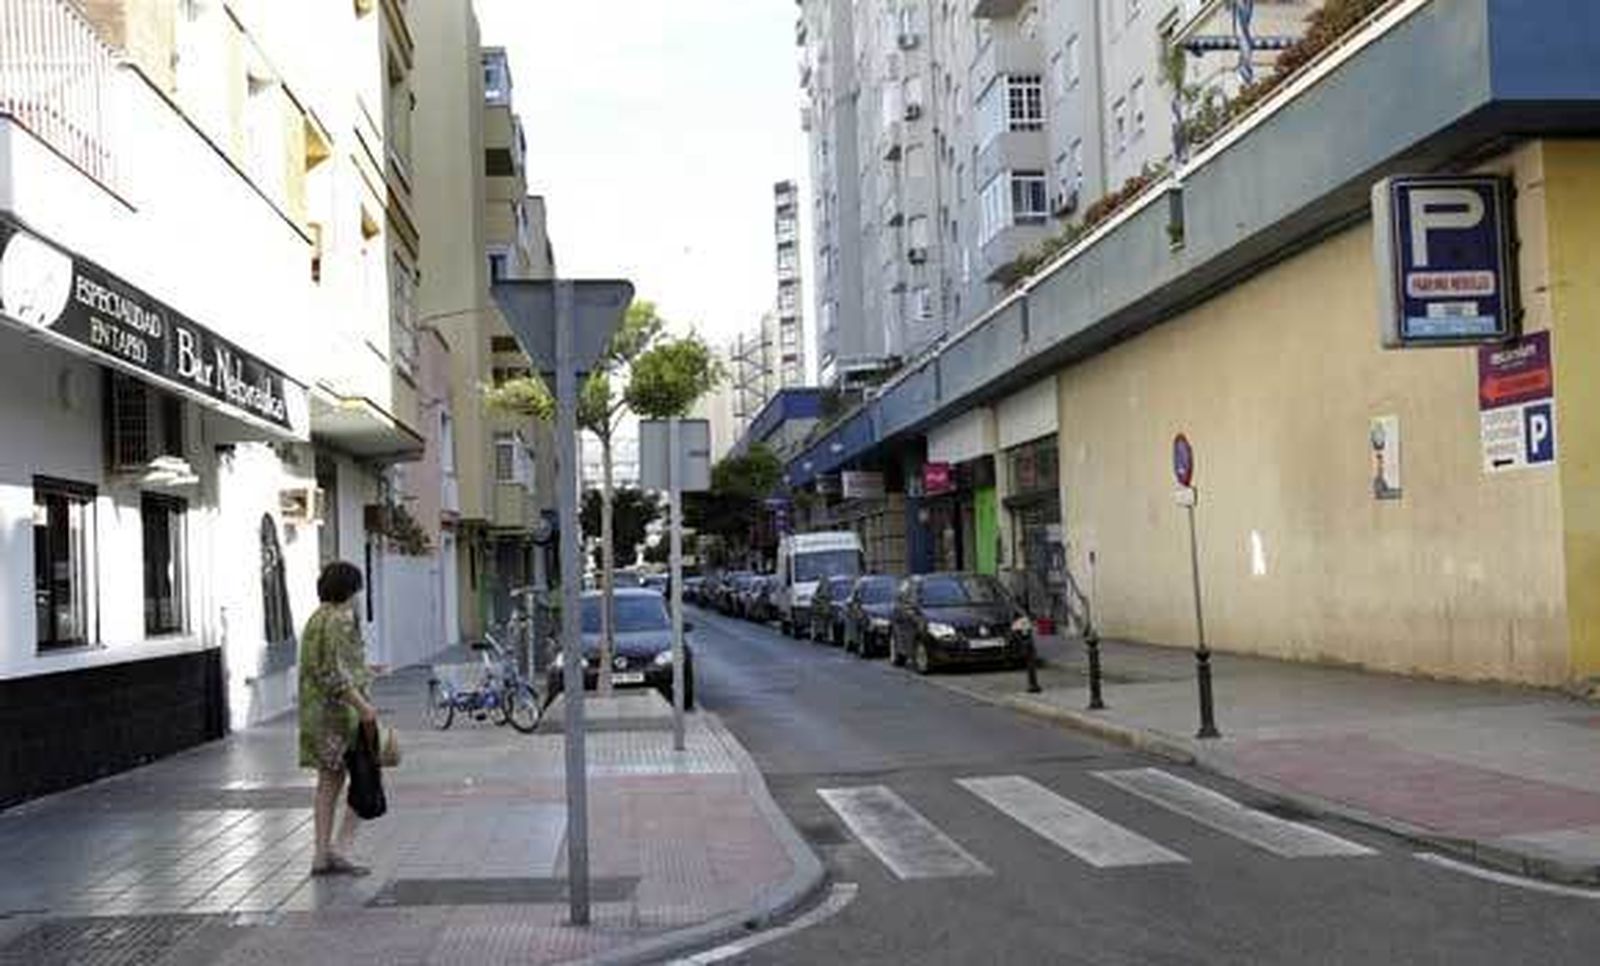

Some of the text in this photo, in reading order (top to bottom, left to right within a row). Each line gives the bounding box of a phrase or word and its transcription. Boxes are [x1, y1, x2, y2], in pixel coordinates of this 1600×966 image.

[1409, 189, 1485, 267] P
[77, 274, 162, 338] ESPECIALIDAD
[90, 316, 109, 345] EN
[176, 327, 214, 387] Bar
[1530, 414, 1548, 453] P
